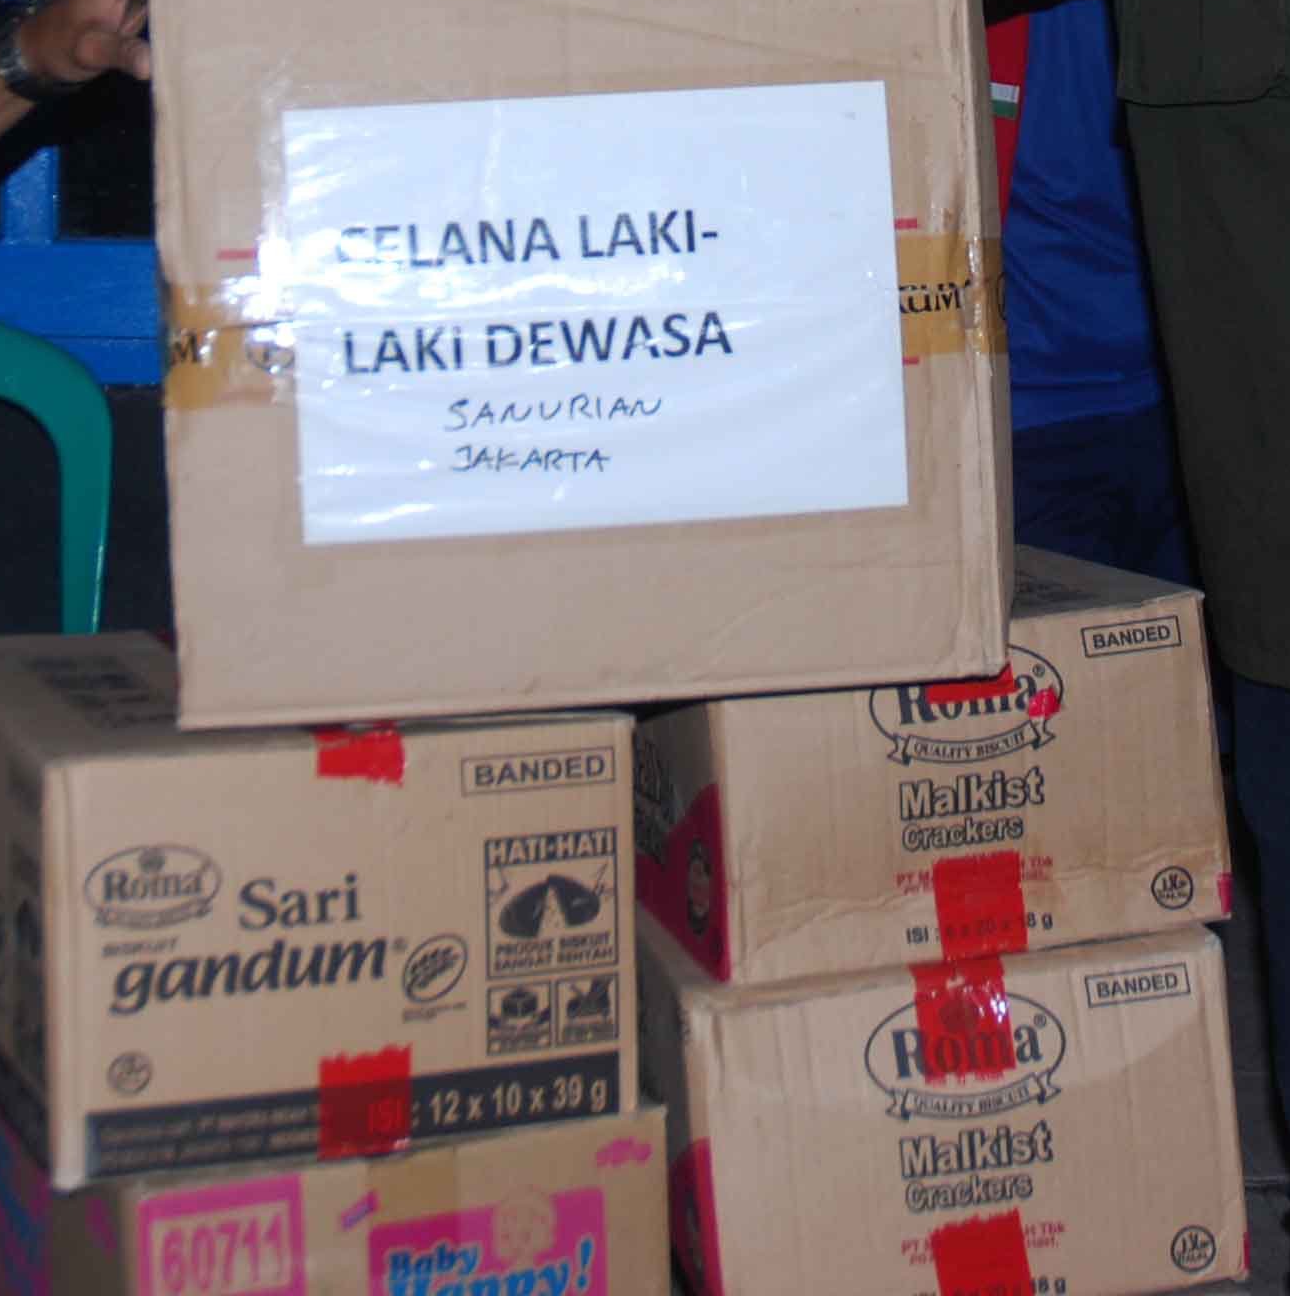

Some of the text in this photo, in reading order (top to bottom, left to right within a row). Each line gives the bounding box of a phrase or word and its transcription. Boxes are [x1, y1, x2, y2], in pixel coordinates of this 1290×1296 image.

[337, 209, 719, 267] CELANA LAKI-
[342, 325, 463, 375] LAKI
[486, 310, 734, 368] DEWASA
[450, 444, 610, 472] JAKARTA
[1092, 624, 1171, 649] BANDED
[913, 730, 1027, 759] QUALITY BISCUIT
[475, 754, 606, 787] BANDED
[899, 765, 1046, 821] Malkist
[902, 815, 1025, 852] Crackers
[102, 869, 204, 903] Roma
[238, 872, 361, 931] Sari
[108, 937, 389, 1017] gandum
[1096, 972, 1179, 999] BANDED
[891, 1023, 1043, 1080] Roma
[429, 1089, 462, 1127] 12
[492, 1082, 524, 1120] 10
[589, 1078, 609, 1113] g
[899, 1119, 1054, 1180] Malkist
[905, 1174, 1034, 1213] Crackers
[387, 1240, 480, 1282] Baby
